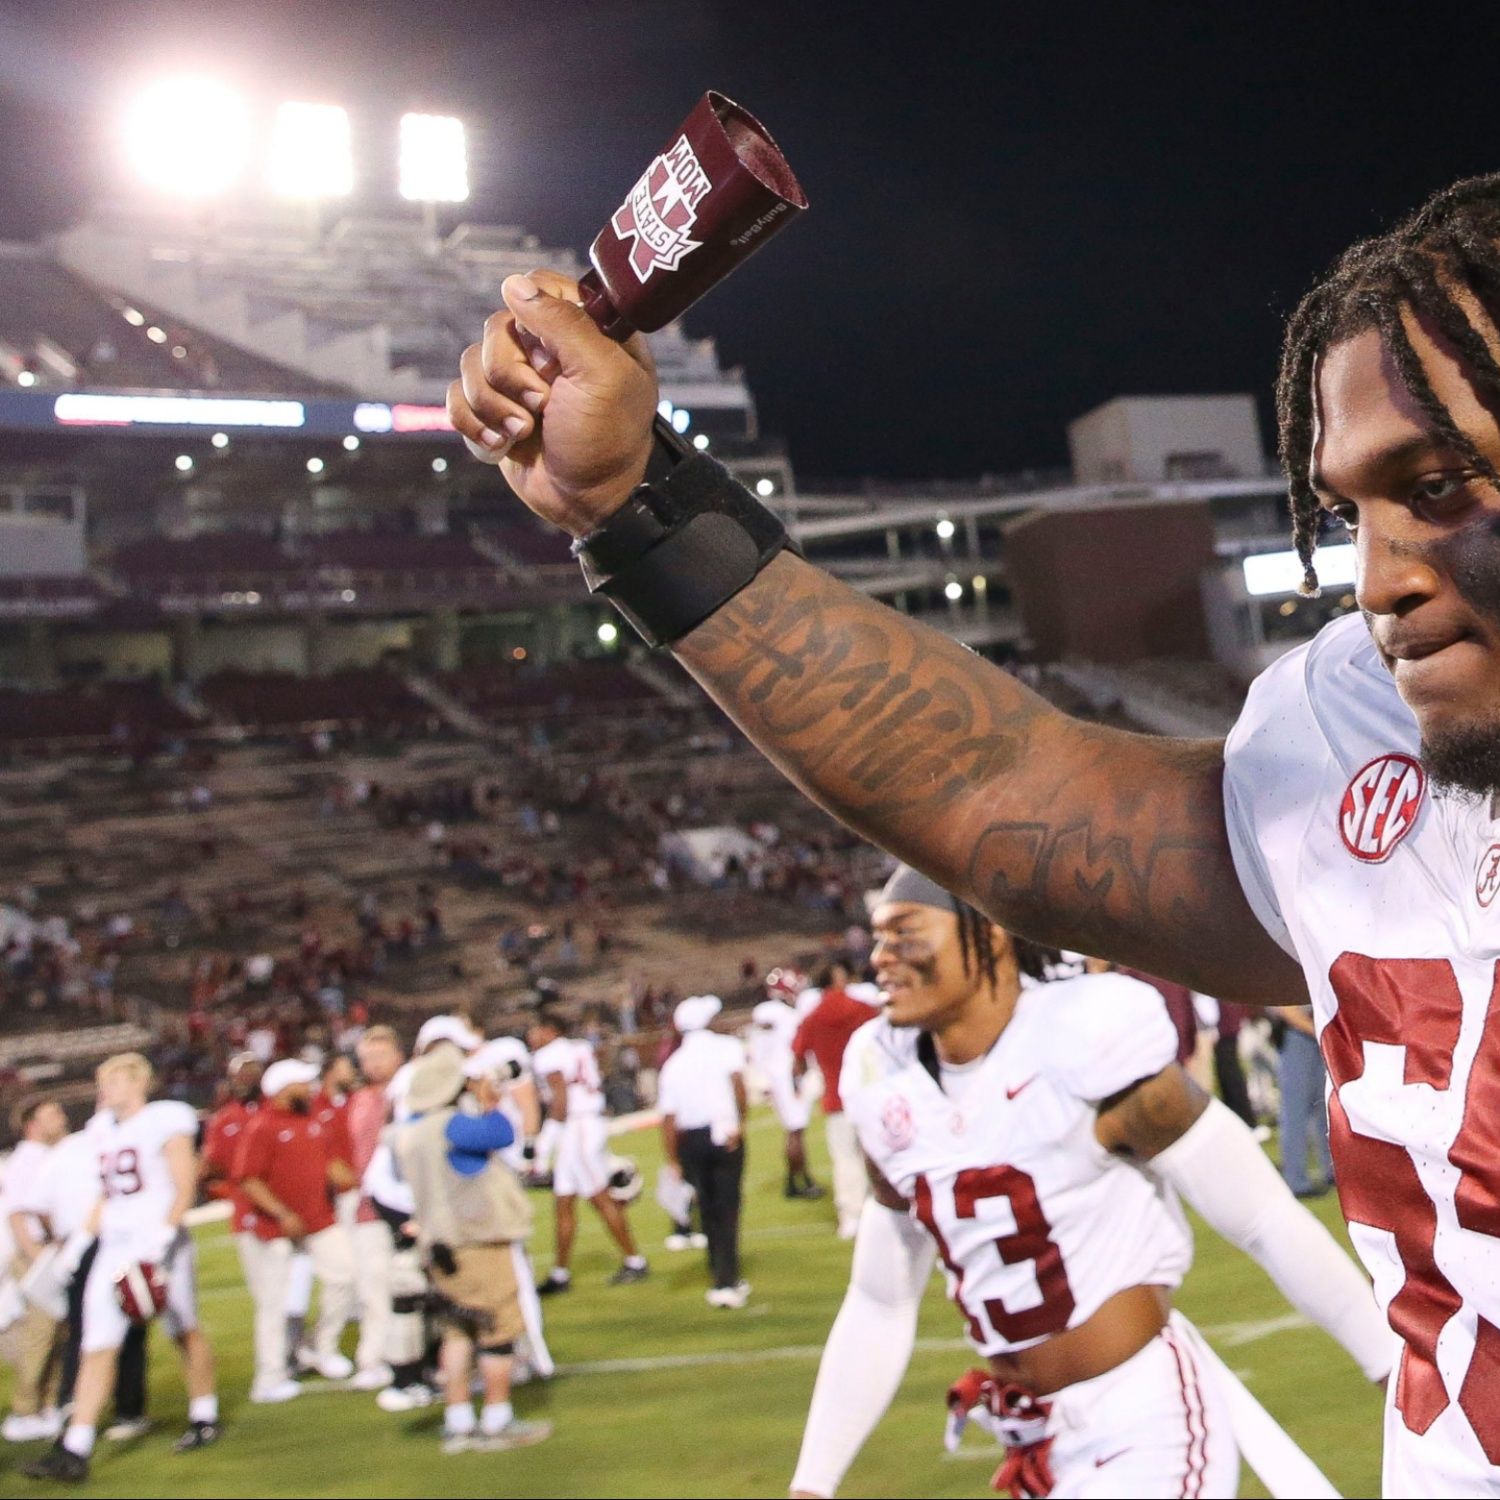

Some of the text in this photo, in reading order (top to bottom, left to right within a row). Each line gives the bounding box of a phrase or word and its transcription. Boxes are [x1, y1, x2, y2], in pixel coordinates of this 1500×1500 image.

[665, 138, 706, 208] MOM
[632, 184, 676, 246] STATE
[1343, 758, 1419, 854] SEC
[914, 1165, 1076, 1343] 13
